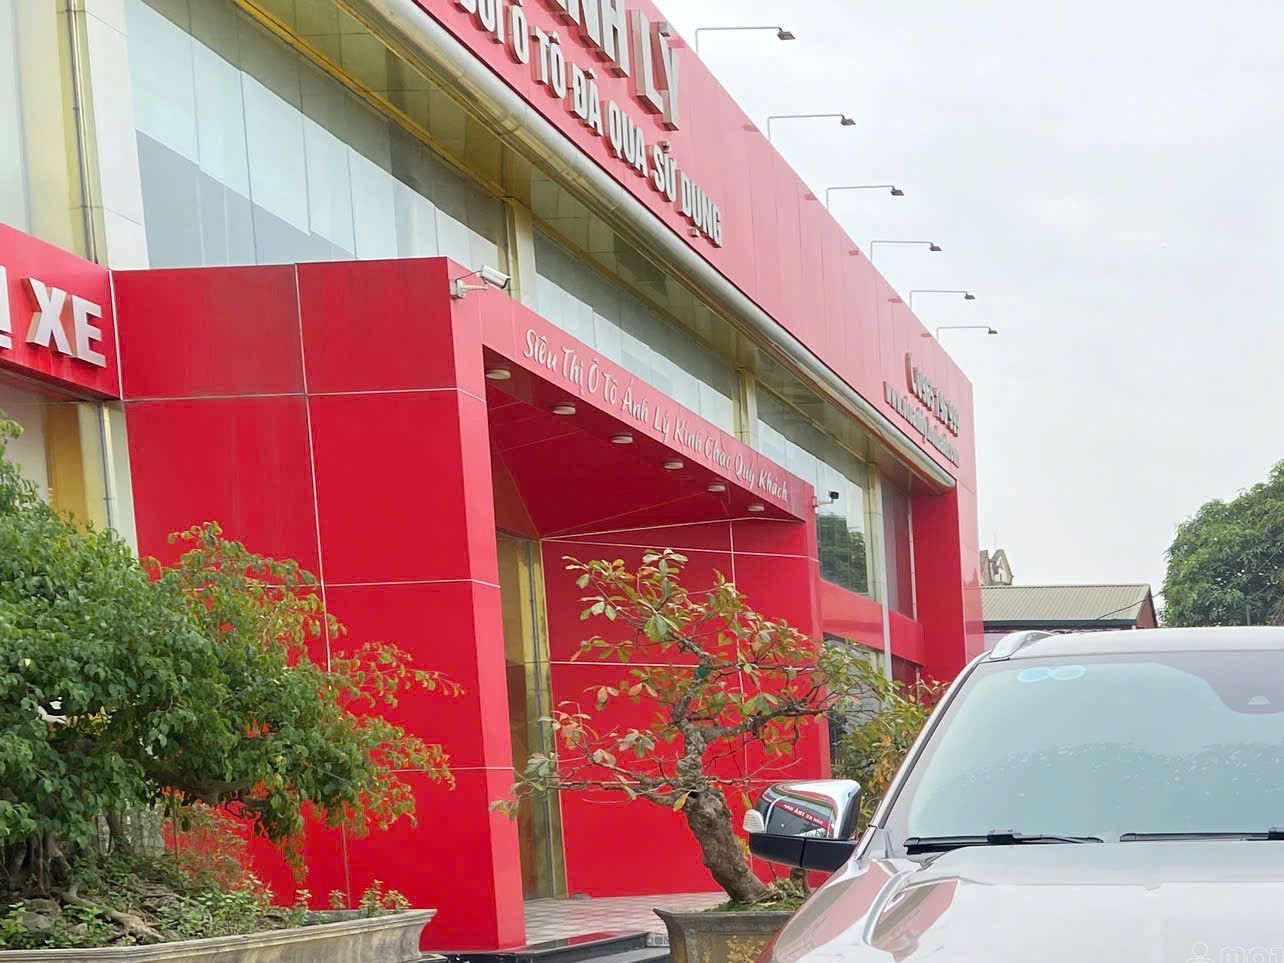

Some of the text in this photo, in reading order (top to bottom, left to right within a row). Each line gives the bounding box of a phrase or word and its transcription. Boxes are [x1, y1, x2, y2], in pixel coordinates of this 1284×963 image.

[512, 0, 529, 64] Ô
[534, 25, 566, 99] TÔ
[608, 100, 649, 178] QUA
[681, 171, 722, 248] DỤNG
[640, 9, 679, 132] LÝ
[28, 277, 107, 368] XE
[523, 328, 557, 373] Siêu
[561, 345, 584, 397] Thị
[587, 356, 599, 394] Ô
[602, 371, 617, 405] Tô
[620, 378, 648, 424] Ánh
[653, 406, 669, 443] Lý
[704, 435, 731, 471] Chào
